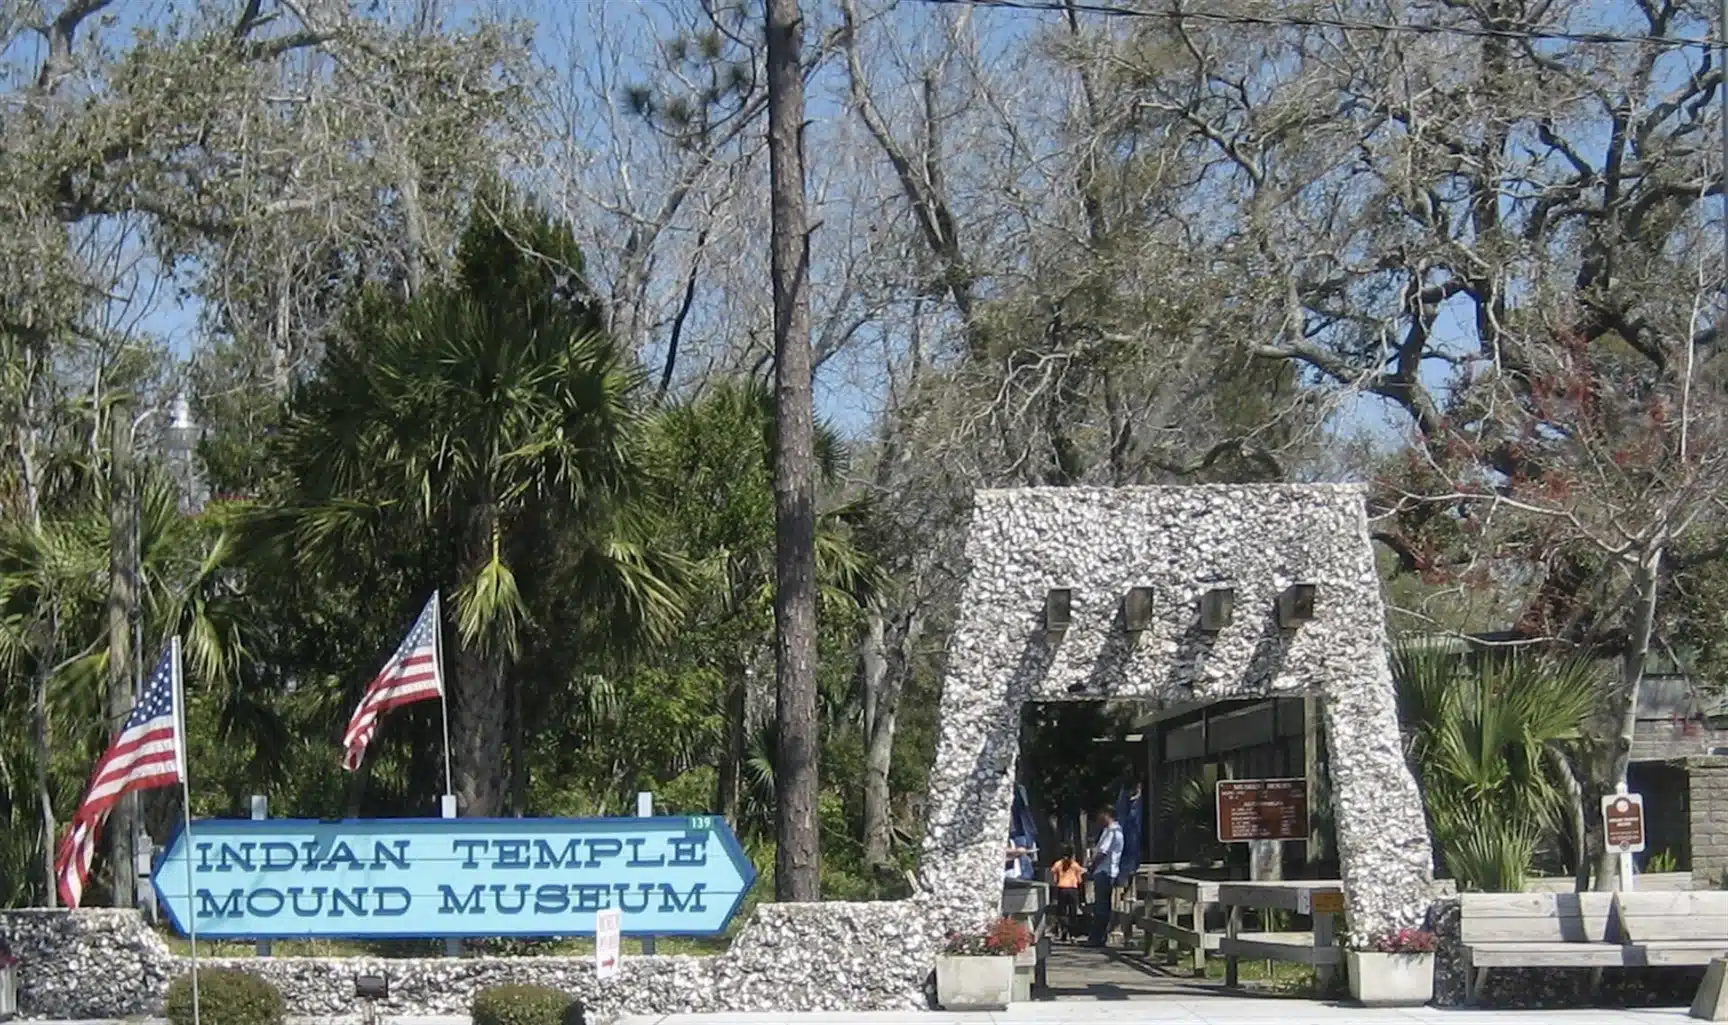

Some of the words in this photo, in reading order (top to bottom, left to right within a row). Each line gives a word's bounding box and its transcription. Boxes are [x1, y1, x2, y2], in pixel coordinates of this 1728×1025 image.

[691, 816, 711, 829] 139
[196, 840, 411, 872] INDIAN
[452, 837, 707, 869] TEMPLE
[196, 884, 411, 918] MOUND
[437, 883, 707, 915] MUSEUM
